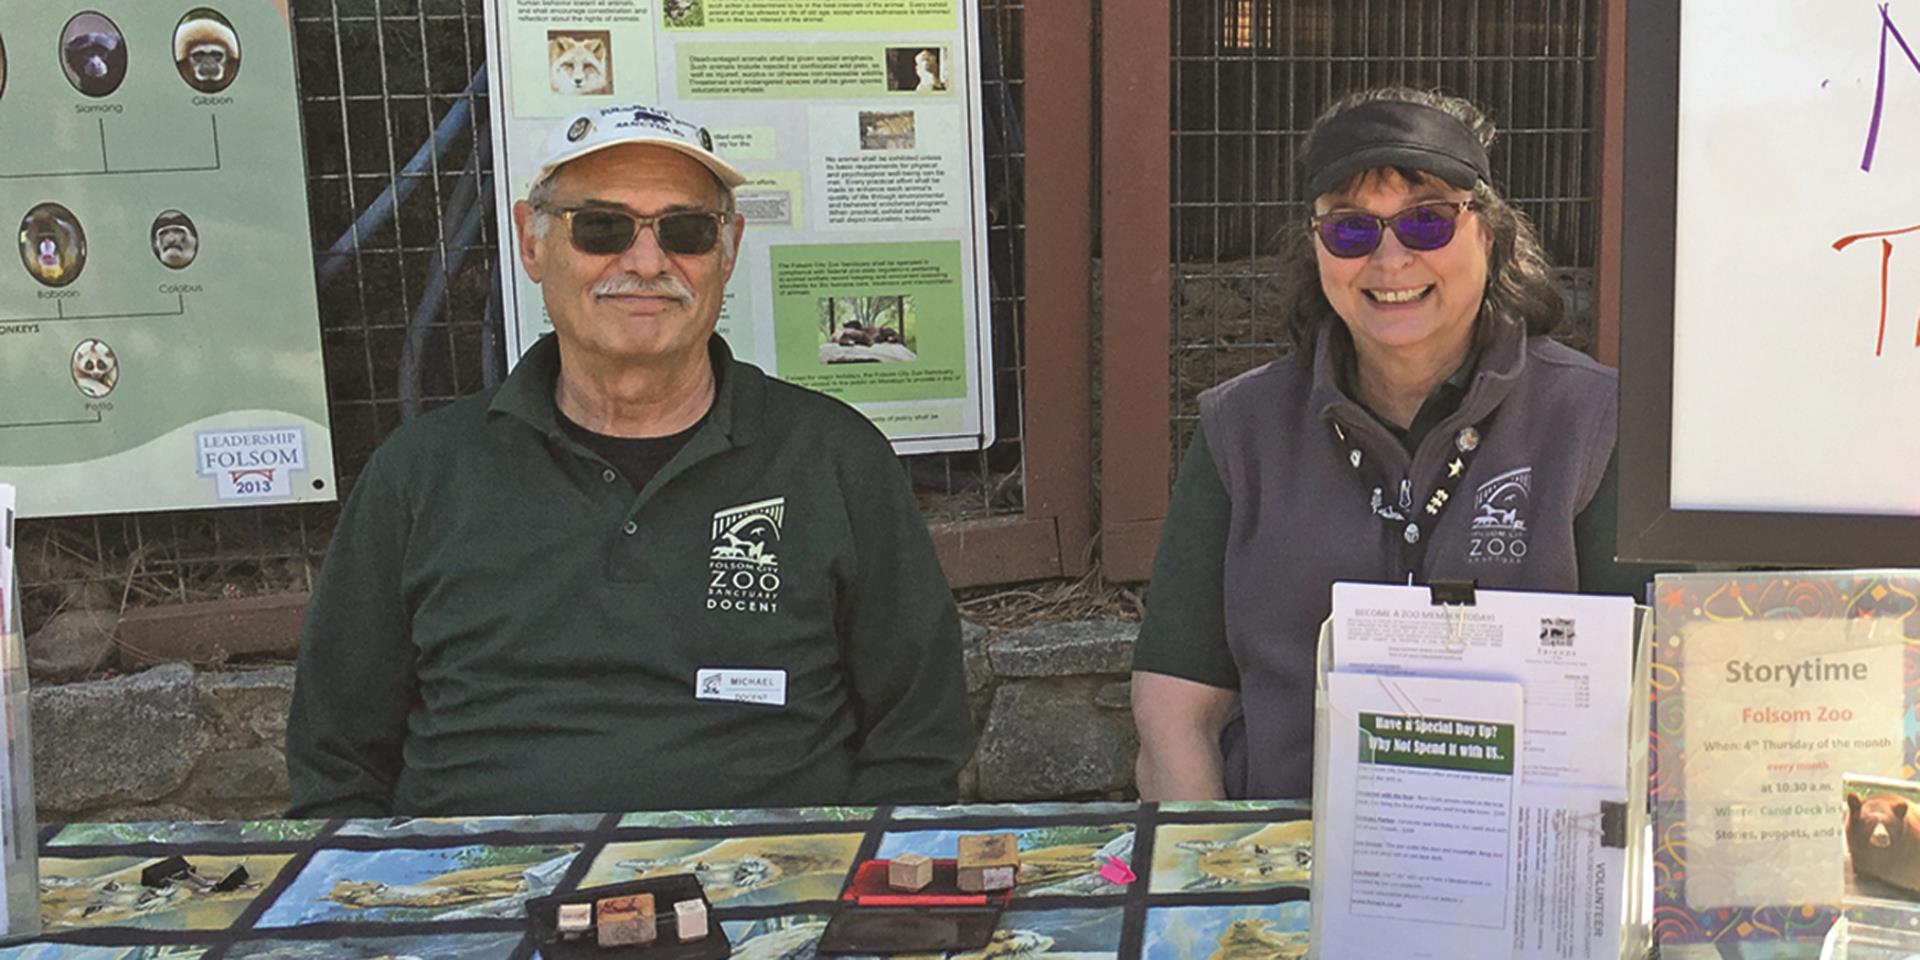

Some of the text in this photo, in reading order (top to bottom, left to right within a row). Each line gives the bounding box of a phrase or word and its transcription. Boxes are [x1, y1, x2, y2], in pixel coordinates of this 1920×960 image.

[192, 96, 234, 107] Gibbon
[75, 104, 123, 114] Siamang
[37, 290, 80, 299] Baboon
[158, 283, 203, 294] Colobus
[1832, 225, 1920, 356] T
[85, 402, 114, 411] Potto
[203, 432, 296, 449] LEADERSHIP
[206, 448, 299, 468] FOLSOM
[236, 480, 272, 494] 2013
[1470, 537, 1528, 558] ZOO
[709, 561, 755, 570] FOLSOM
[710, 570, 781, 592] ZOO
[708, 588, 779, 600] SANCTUARY
[706, 598, 777, 613] DOCENT
[1355, 608, 1390, 618] BECOME
[1392, 610, 1400, 618] A
[1402, 610, 1420, 619] ZOO
[1726, 657, 1868, 688] Storytime
[730, 677, 774, 687] MICHAEL
[1743, 706, 1853, 724] Folsom Zoo
[1376, 716, 1403, 730] Have
[1414, 719, 1453, 734] Special
[1455, 722, 1476, 738] Day
[1478, 724, 1498, 739] Up?
[1393, 738, 1411, 753] Not
[1413, 739, 1446, 755] Spend
[1458, 744, 1483, 759] with
[1704, 741, 1741, 752] When:
[1762, 739, 1815, 751] Thursday
[1817, 739, 1830, 750] of
[1832, 737, 1849, 749] the
[1853, 737, 1891, 749] month
[1766, 760, 1829, 773] every month
[1761, 781, 1834, 793] at 10:30 a.m.
[1794, 803, 1823, 815] Deck
[1825, 803, 1837, 814] in
[1760, 828, 1811, 842] puppets,
[1813, 827, 1833, 840] and
[1594, 862, 1606, 938] VOLUNTEER
